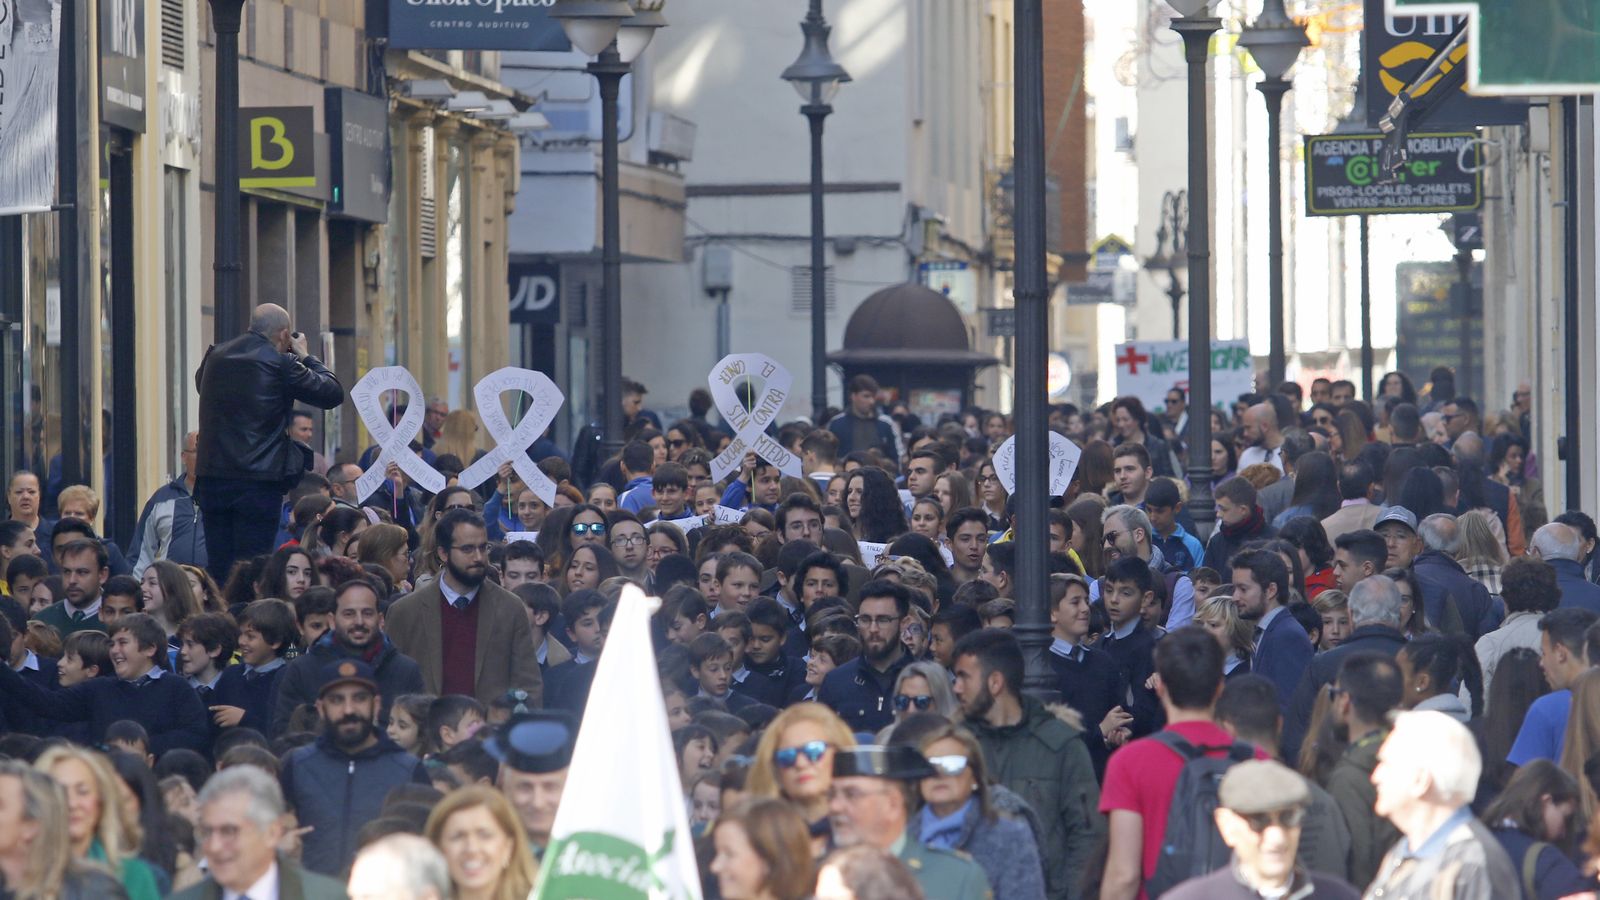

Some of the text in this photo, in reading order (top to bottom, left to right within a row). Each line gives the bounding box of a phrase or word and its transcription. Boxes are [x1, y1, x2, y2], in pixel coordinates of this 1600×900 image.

[429, 21, 530, 30] CENTRO AUDITIVO
[250, 116, 295, 171] B
[1313, 140, 1370, 156] AGENCIA
[760, 361, 775, 379] EL
[727, 404, 750, 431] SIN
[752, 388, 786, 426] CONTRA
[716, 438, 748, 471] LUCHAR
[752, 433, 791, 468] MIEDO
